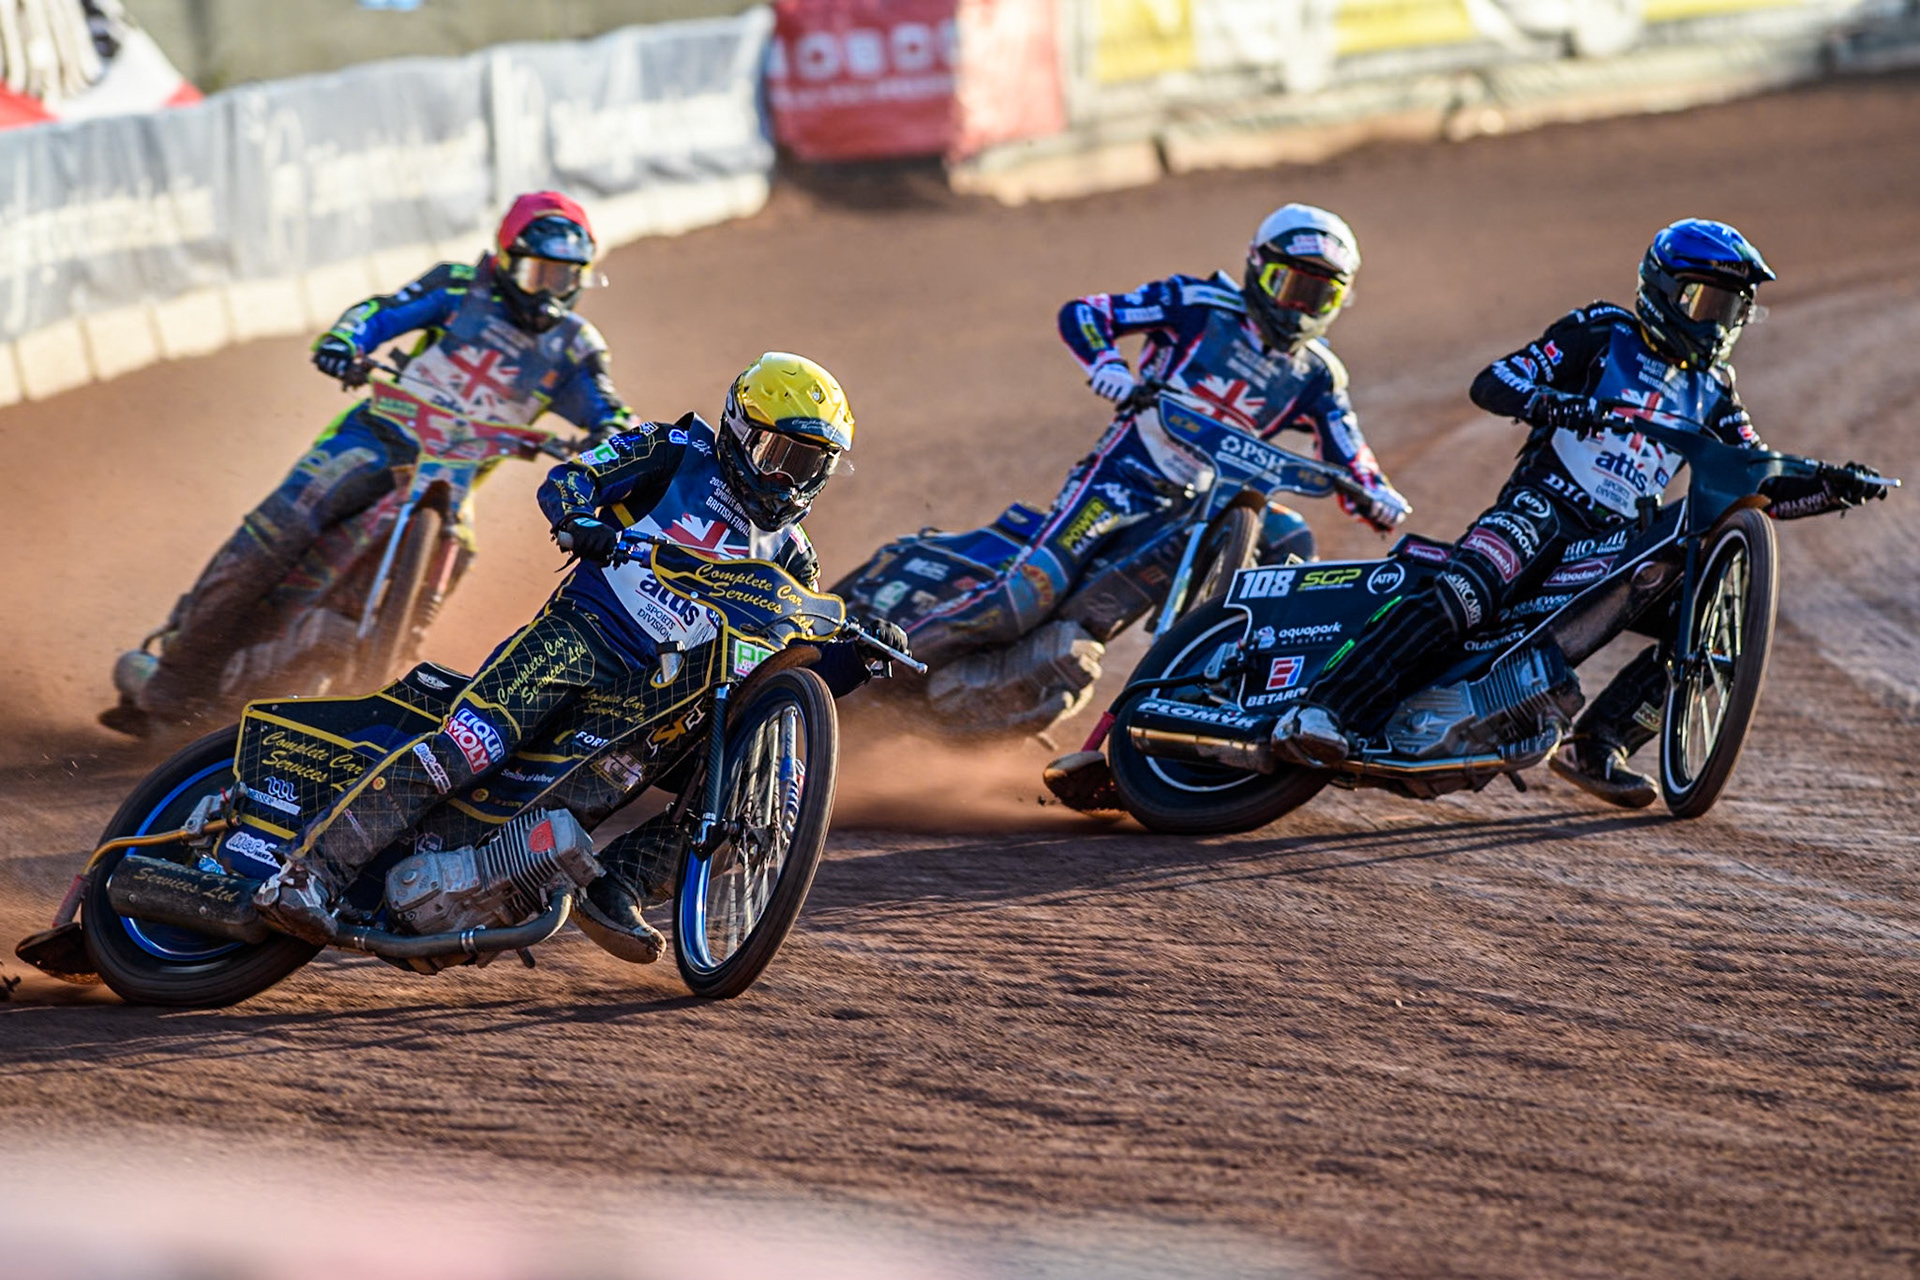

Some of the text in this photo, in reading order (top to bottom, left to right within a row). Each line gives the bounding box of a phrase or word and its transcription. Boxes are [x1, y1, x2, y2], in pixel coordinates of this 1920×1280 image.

[709, 476, 727, 491] 2024
[713, 487, 735, 507] SPORTS
[705, 495, 751, 538] BRITISH FINAL
[695, 563, 804, 607] Complete Car
[708, 581, 783, 615] Services
[1239, 569, 1297, 599] 108
[637, 608, 672, 642] DIVISION
[645, 603, 676, 631] SPORTS
[1278, 622, 1342, 639] aquapark
[567, 641, 588, 664] Ltd
[497, 635, 568, 706] Complete Car
[262, 731, 364, 775] Complete Car
[448, 720, 490, 768] MOLY
[262, 751, 328, 783] Services
[134, 867, 240, 902] Services Ltd
